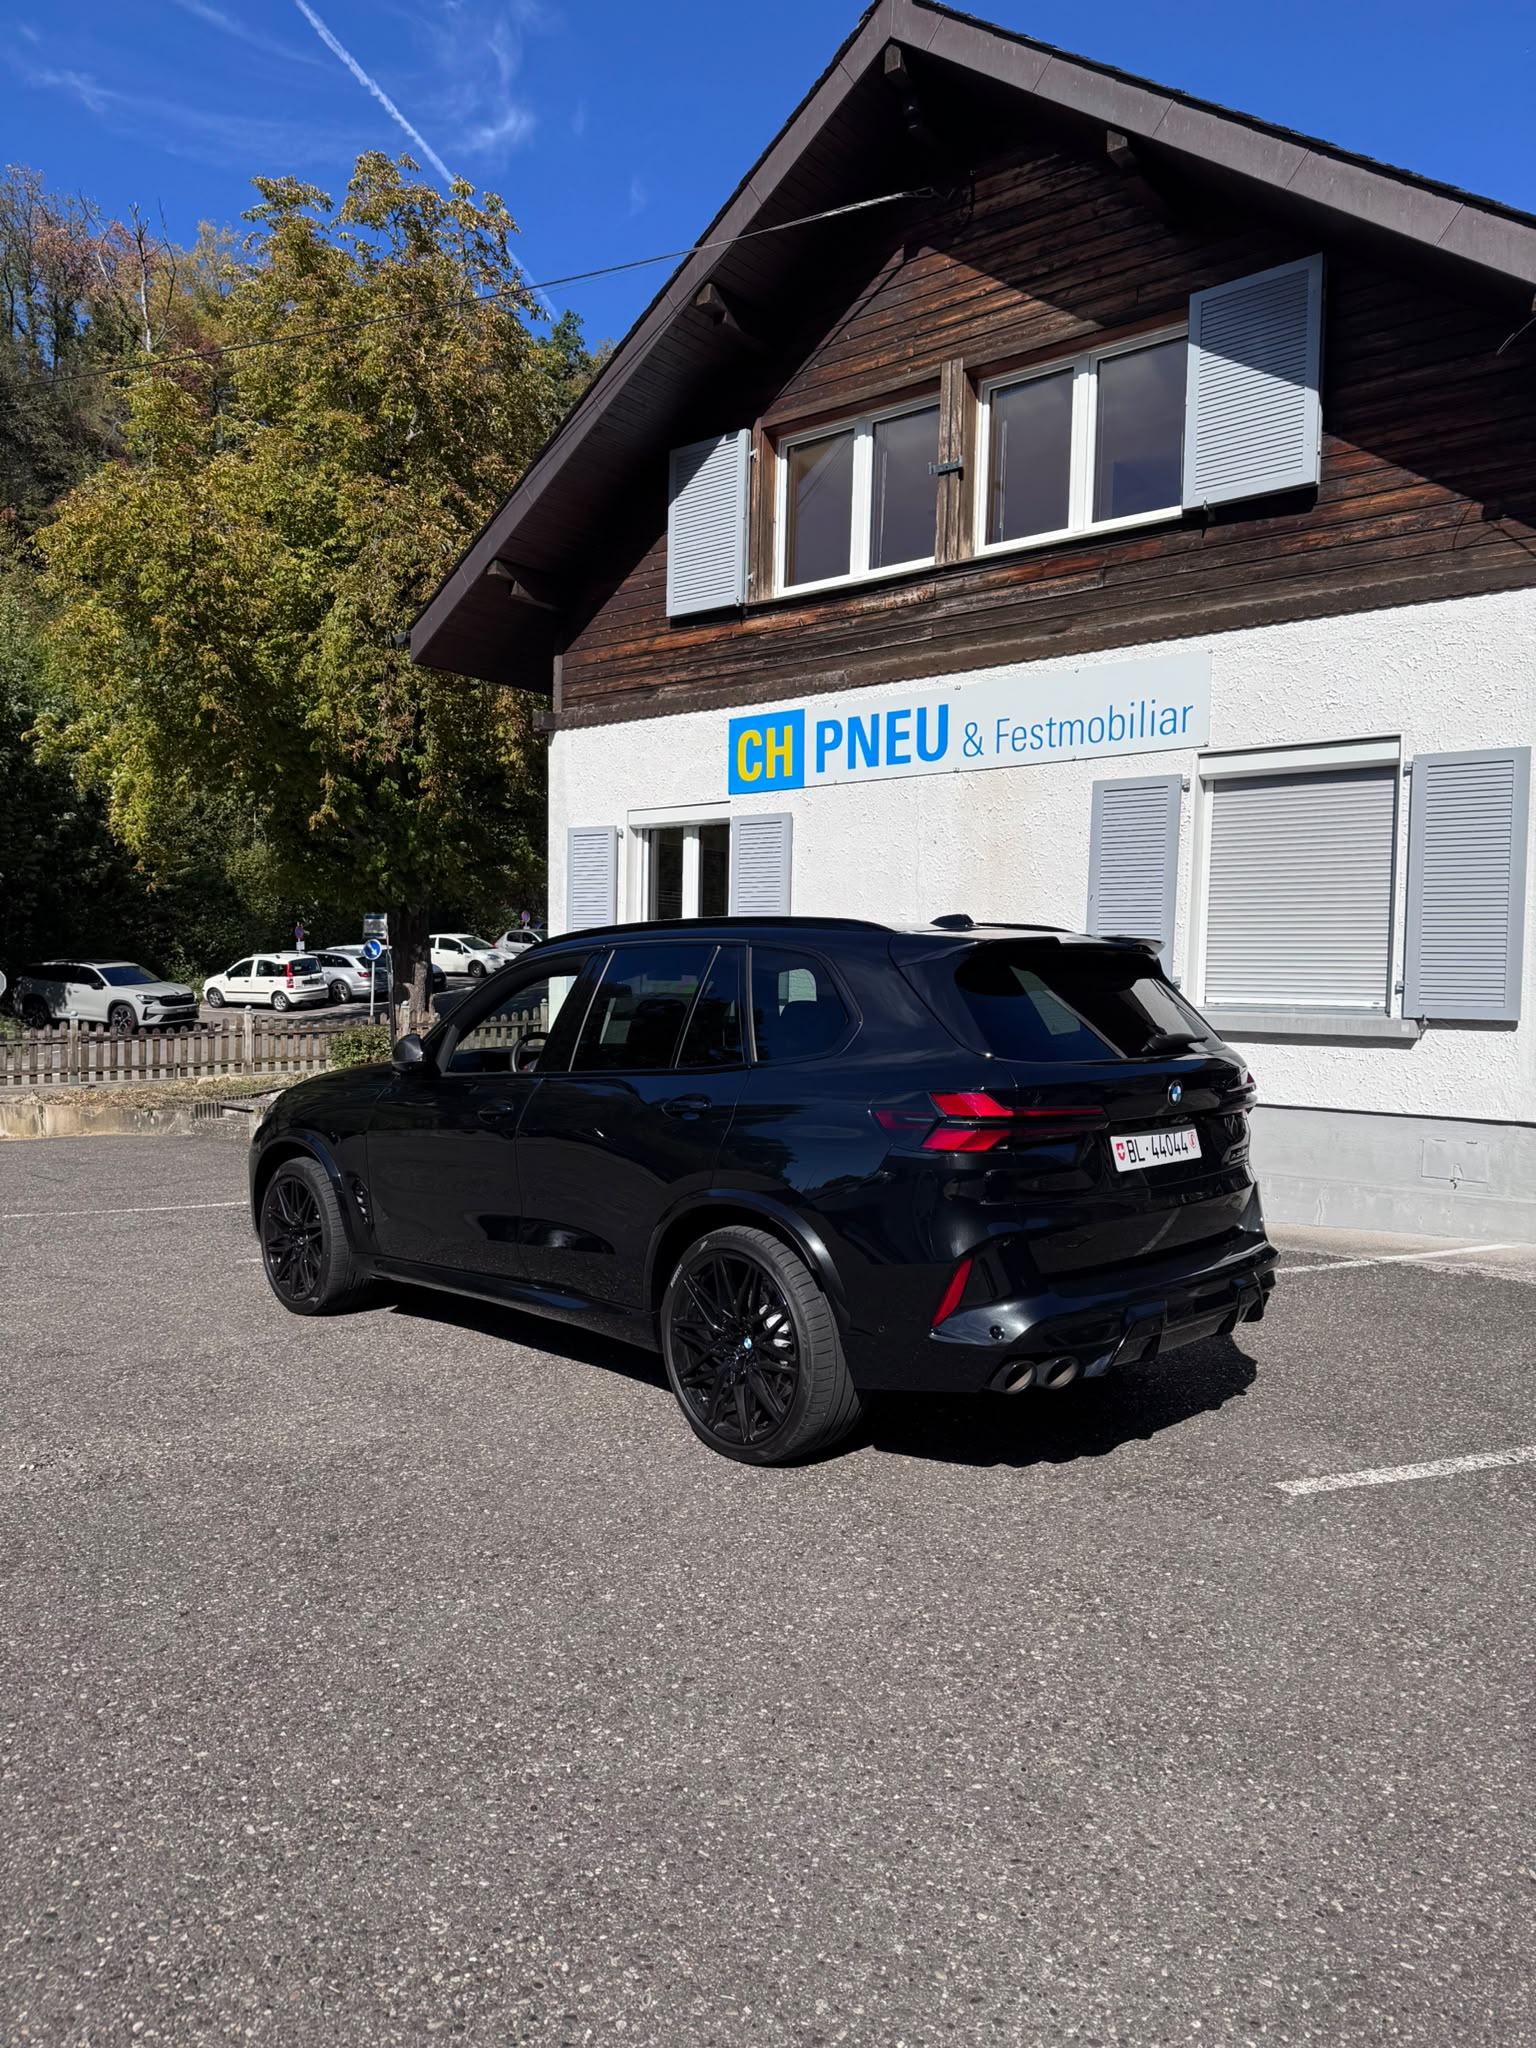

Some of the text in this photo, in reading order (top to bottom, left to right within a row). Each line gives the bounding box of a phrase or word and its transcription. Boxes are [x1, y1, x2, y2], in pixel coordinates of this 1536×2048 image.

[737, 699, 1194, 782] CH PNEU & Festmobiliar
